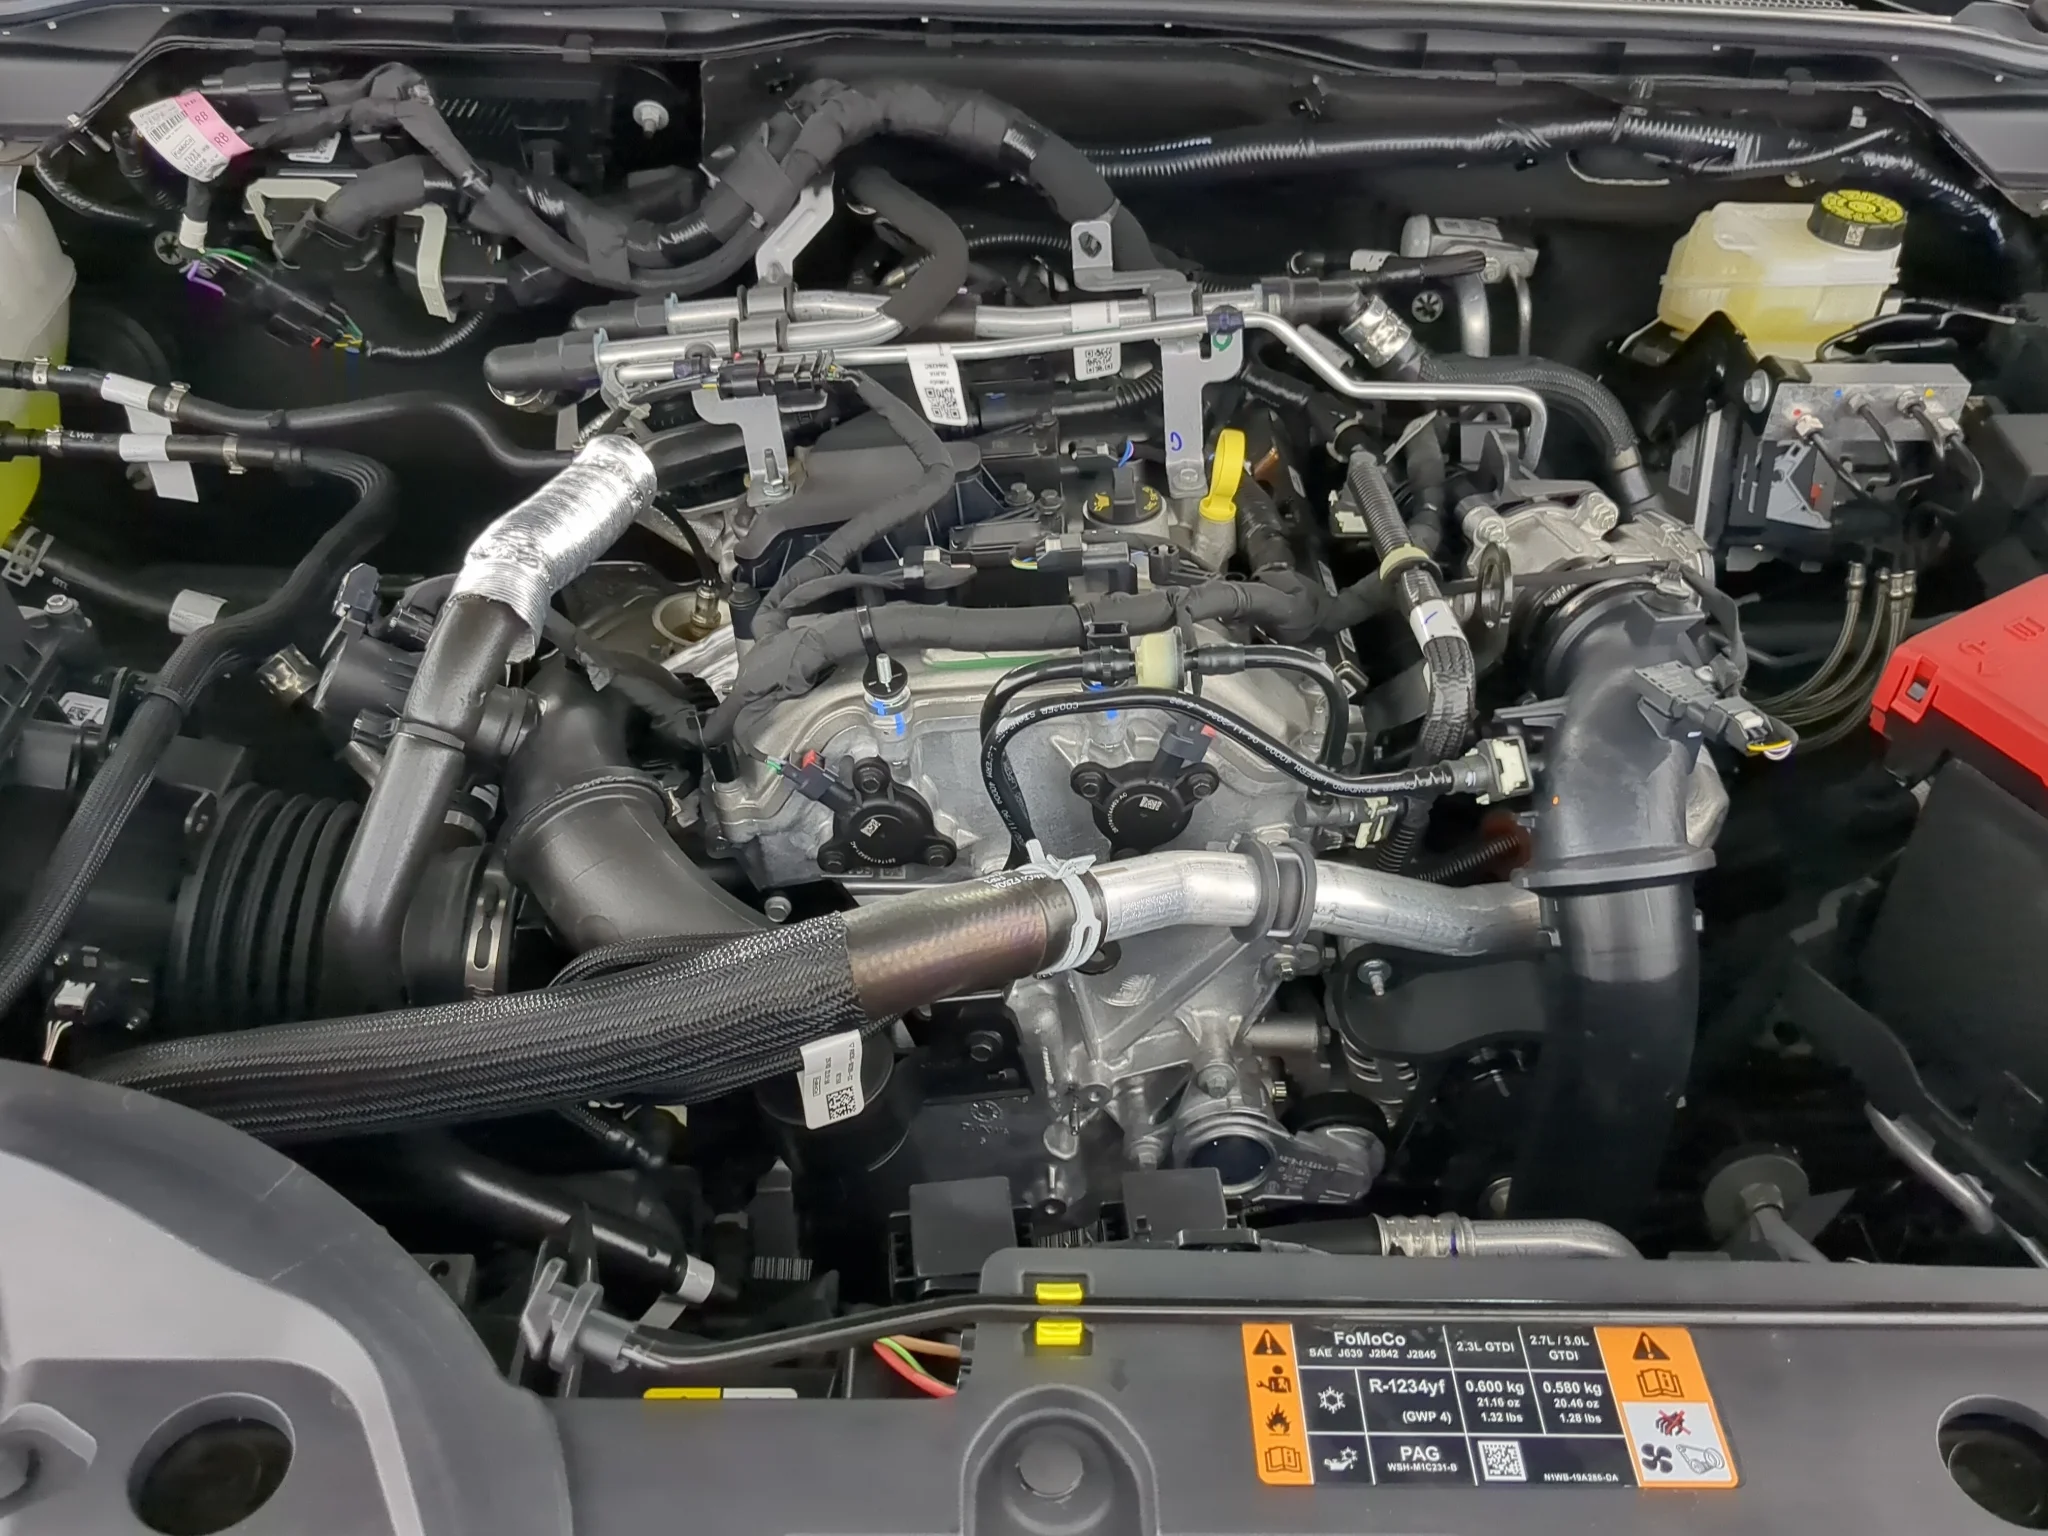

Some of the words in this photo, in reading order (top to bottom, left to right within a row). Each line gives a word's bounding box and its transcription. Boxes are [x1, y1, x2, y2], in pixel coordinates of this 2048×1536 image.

[194, 111, 209, 126] RB
[214, 131, 230, 148] RB
[1333, 1331, 1407, 1347] FoMoCo
[1529, 1335, 1556, 1346] 2.7L
[1563, 1335, 1590, 1347] 3.0L
[1309, 1347, 1333, 1358] SAE
[1338, 1348, 1363, 1358] J639
[1368, 1348, 1400, 1359] J2842
[1406, 1349, 1437, 1360] J2845
[1456, 1341, 1482, 1352] 2.3L
[1484, 1342, 1515, 1353] GTDI
[1548, 1350, 1580, 1361] GTDI
[1368, 1378, 1446, 1398] R-1234yf
[1465, 1380, 1503, 1393] 0.600
[1506, 1380, 1525, 1396] kg
[1542, 1381, 1580, 1394] 0.580
[1584, 1381, 1603, 1397] kg
[1476, 1397, 1506, 1408] 21.16
[1507, 1399, 1521, 1408] oz
[1553, 1398, 1584, 1409] 20.46
[1586, 1400, 1600, 1409] oz
[1402, 1411, 1437, 1425] (GWP
[1440, 1411, 1452, 1425] 4)
[1480, 1411, 1504, 1423] 1.32
[1505, 1412, 1524, 1423] lbs
[1559, 1412, 1582, 1424] 1.28
[1584, 1413, 1602, 1424] lbs
[1399, 1445, 1441, 1462] PAG
